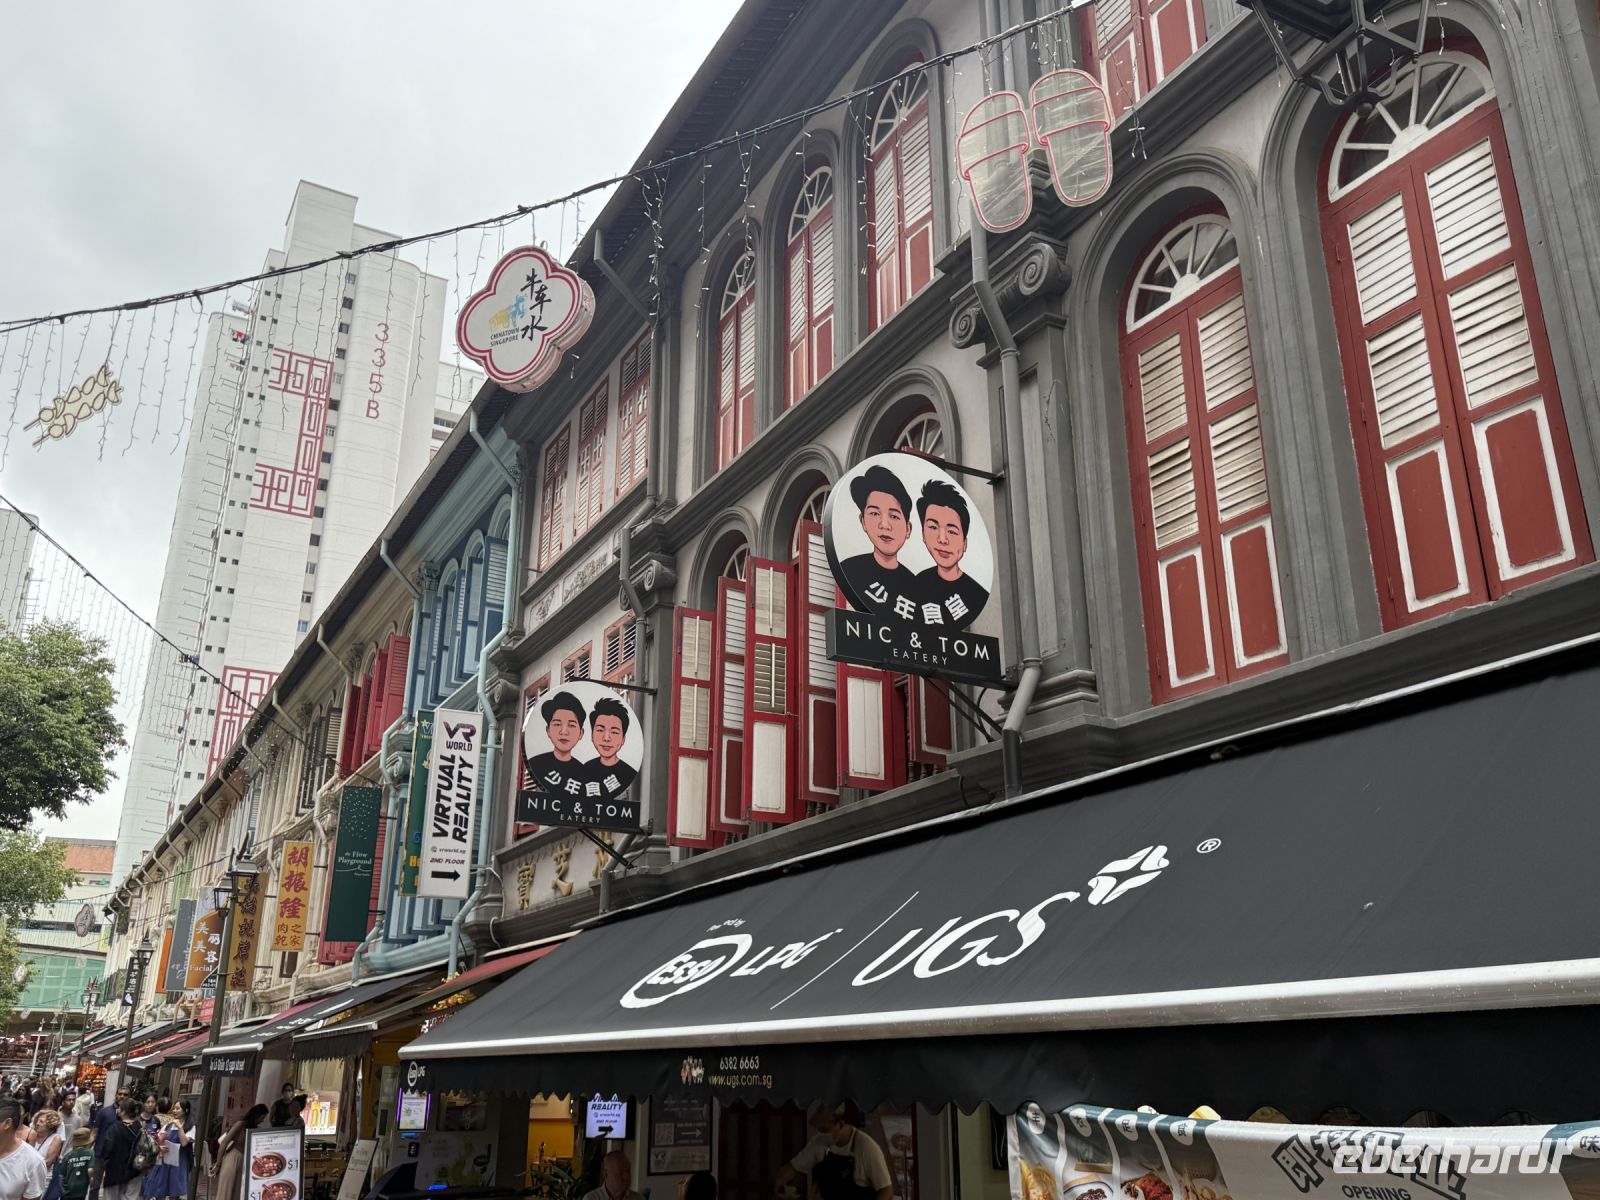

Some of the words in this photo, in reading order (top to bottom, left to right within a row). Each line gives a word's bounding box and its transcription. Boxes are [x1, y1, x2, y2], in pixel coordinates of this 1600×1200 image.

[490, 327, 520, 341] CHINATOWN
[490, 334, 519, 348] SINGAPORE
[365, 322, 389, 420] 335B
[864, 581, 969, 625] 少年食堂
[846, 620, 892, 644] NIC
[909, 631, 923, 650] &
[938, 636, 990, 661] TOM
[893, 648, 949, 666] EATERY
[446, 741, 473, 752] WORLD
[544, 770, 621, 797] 少年食堂
[432, 754, 456, 838] VIRTUAL
[452, 756, 474, 844] REALITY
[527, 797, 561, 812] NIC
[573, 802, 583, 814] &
[595, 803, 633, 819] TOM
[560, 813, 601, 824] EATERY
[338, 856, 372, 866] Playground
[279, 846, 310, 919] 胡振隆
[852, 891, 1080, 987] UGS
[729, 928, 845, 977] LPG
[719, 1057, 738, 1070] 6382
[739, 1055, 760, 1070] 6663
[708, 1074, 773, 1089] www.ugs.com.sg
[1341, 1183, 1412, 1200] OPENING
